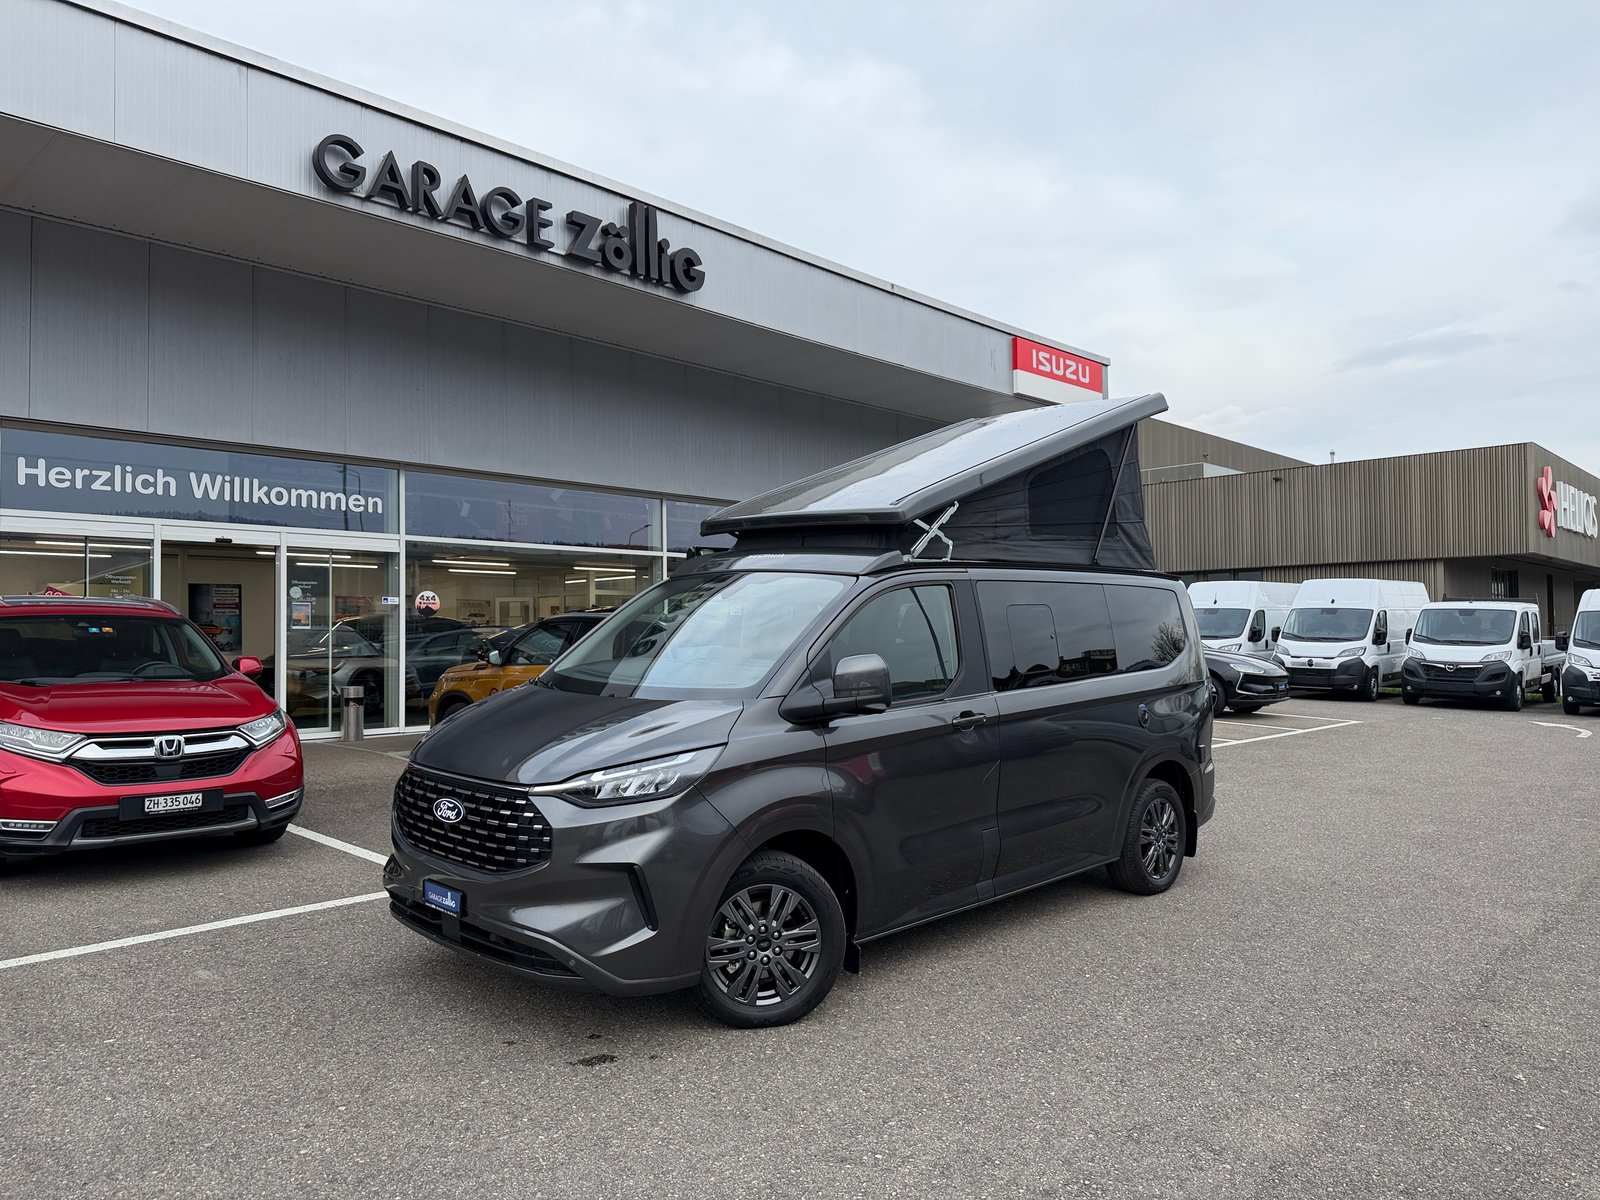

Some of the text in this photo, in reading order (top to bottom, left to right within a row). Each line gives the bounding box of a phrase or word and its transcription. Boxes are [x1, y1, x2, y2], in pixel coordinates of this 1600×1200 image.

[312, 133, 555, 250] GARAGE
[1032, 348, 1090, 384] ISUZU
[17, 456, 382, 514] Herzlich Willkommen
[1556, 480, 1598, 539] HELIOS
[437, 800, 459, 820] Ford
